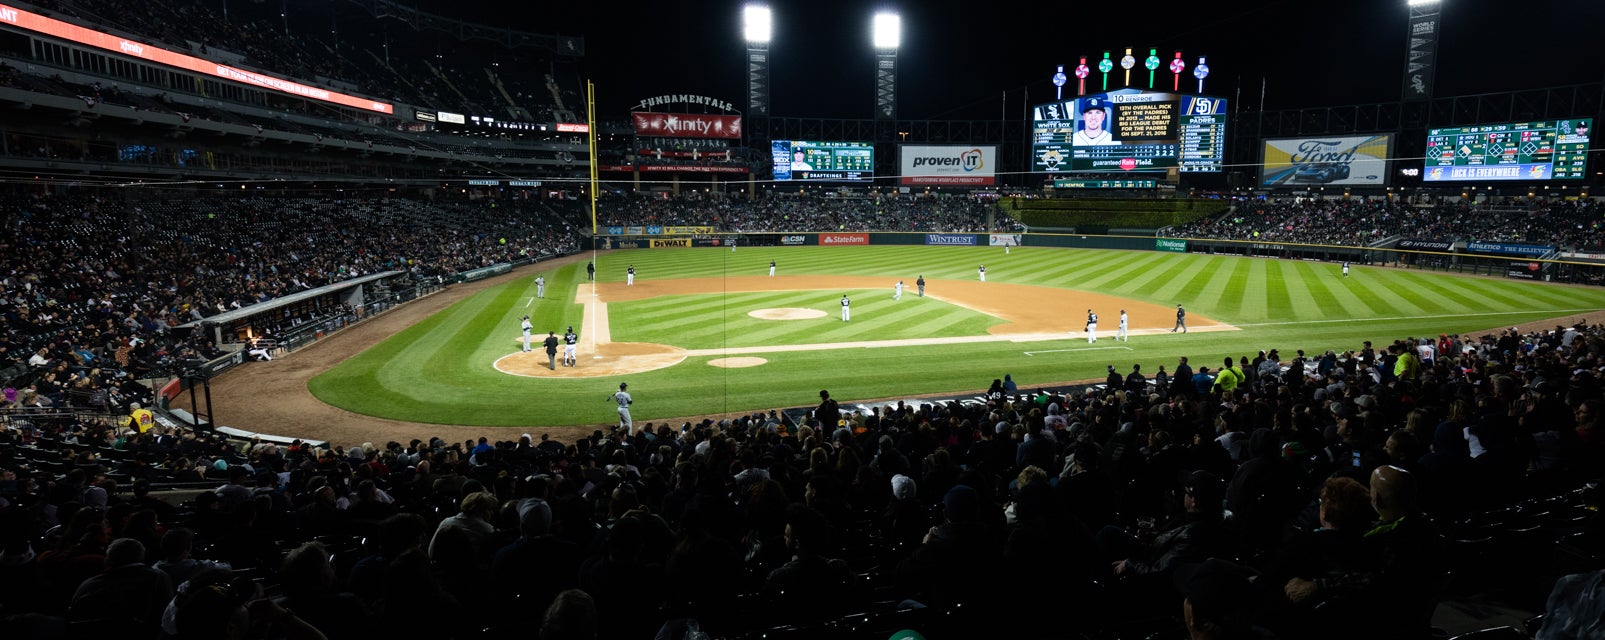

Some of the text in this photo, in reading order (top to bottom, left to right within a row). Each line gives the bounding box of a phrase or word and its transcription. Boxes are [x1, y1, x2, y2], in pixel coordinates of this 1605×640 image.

[217, 66, 229, 76] GET
[640, 94, 732, 112] FUNDAMENTALS
[663, 116, 712, 134] xfinity
[913, 156, 978, 169] proven IT
[1477, 168, 1520, 177] EVERYWHERE
[930, 235, 973, 243] WINTRUST
[1412, 241, 1449, 249] HYUNDAI
